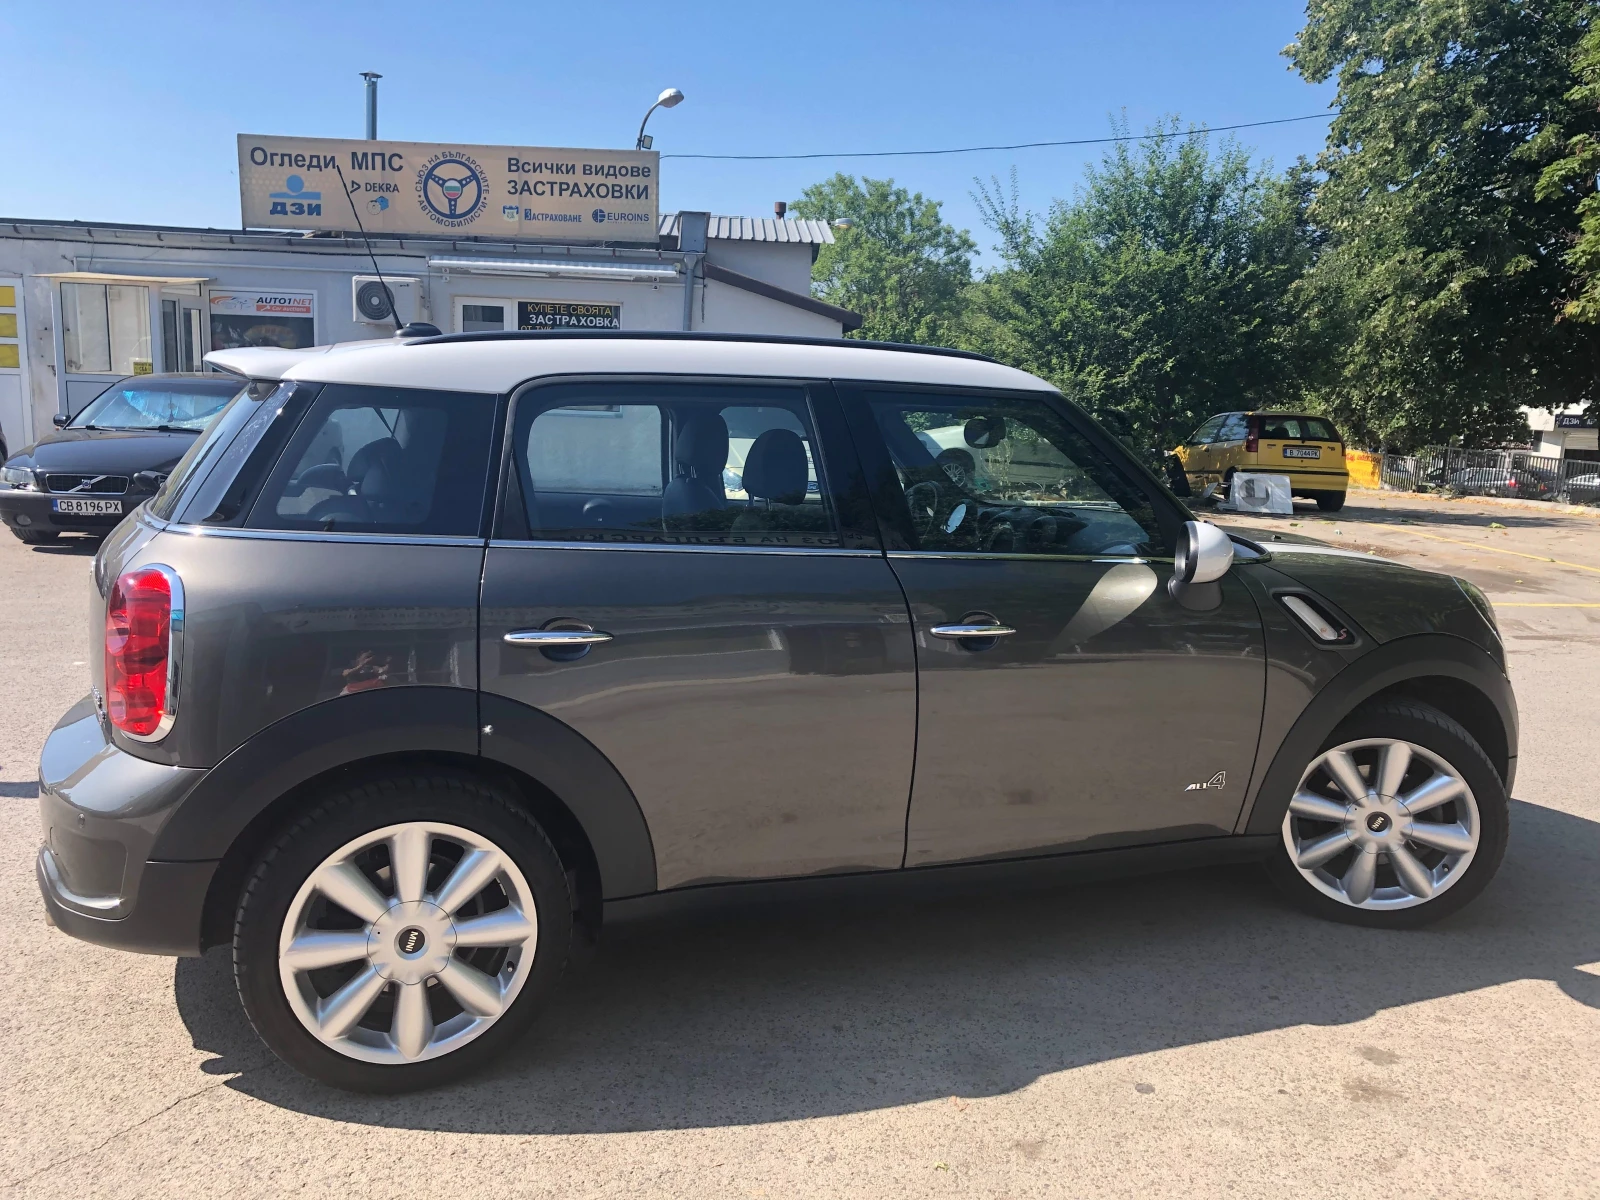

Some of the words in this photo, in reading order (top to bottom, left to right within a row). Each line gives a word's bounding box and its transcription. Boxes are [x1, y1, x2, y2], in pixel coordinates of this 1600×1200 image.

[250, 146, 336, 172] Огледи
[351, 152, 404, 172] МПС
[507, 157, 576, 176] Всички
[582, 164, 651, 179] видове
[415, 164, 429, 193] СЪЮЗ
[427, 154, 441, 165] НА
[441, 151, 490, 195] БЪЛГАРСКИТЕ
[365, 182, 400, 193] DEKRA
[507, 180, 649, 200] ЗАСТРАХОВКИ
[269, 201, 322, 217] ДЗИ
[417, 200, 488, 228] АВТОМОБИЛИСТИ
[607, 212, 650, 222] EUROINS
[527, 303, 567, 314] КУПЕТЕ
[570, 305, 612, 316] СВОЯТА
[529, 314, 620, 328] ЗАСТРАХОВКА
[76, 500, 103, 512] 8196
[405, 931, 418, 951] MINI
